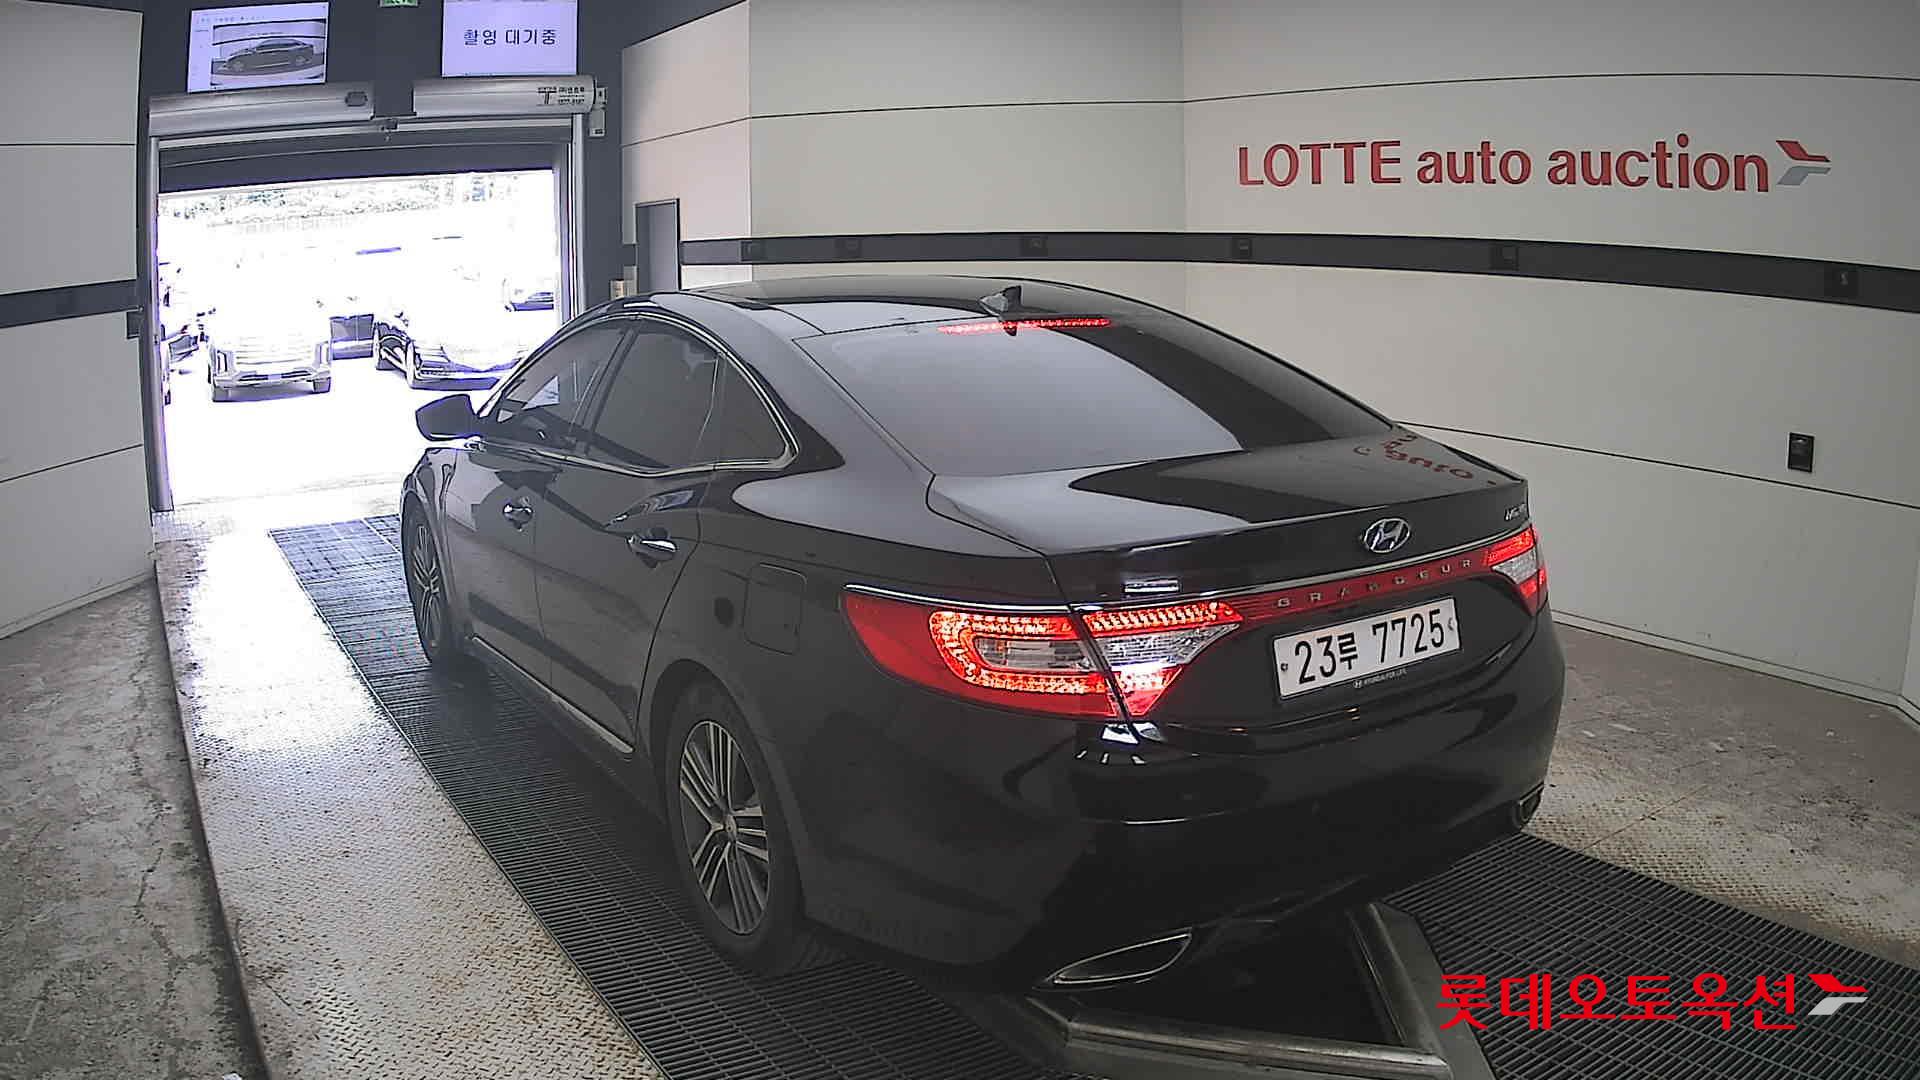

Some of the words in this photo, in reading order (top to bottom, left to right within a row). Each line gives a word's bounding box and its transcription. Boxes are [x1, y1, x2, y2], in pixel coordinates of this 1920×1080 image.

[464, 29, 497, 46] 촬영
[505, 29, 557, 46] 대기중
[1238, 140, 1401, 187] LOTTE
[1416, 141, 1532, 185] auto
[1547, 133, 1769, 193] auction
[1294, 632, 1359, 685] 23루
[1371, 608, 1446, 664] 7725
